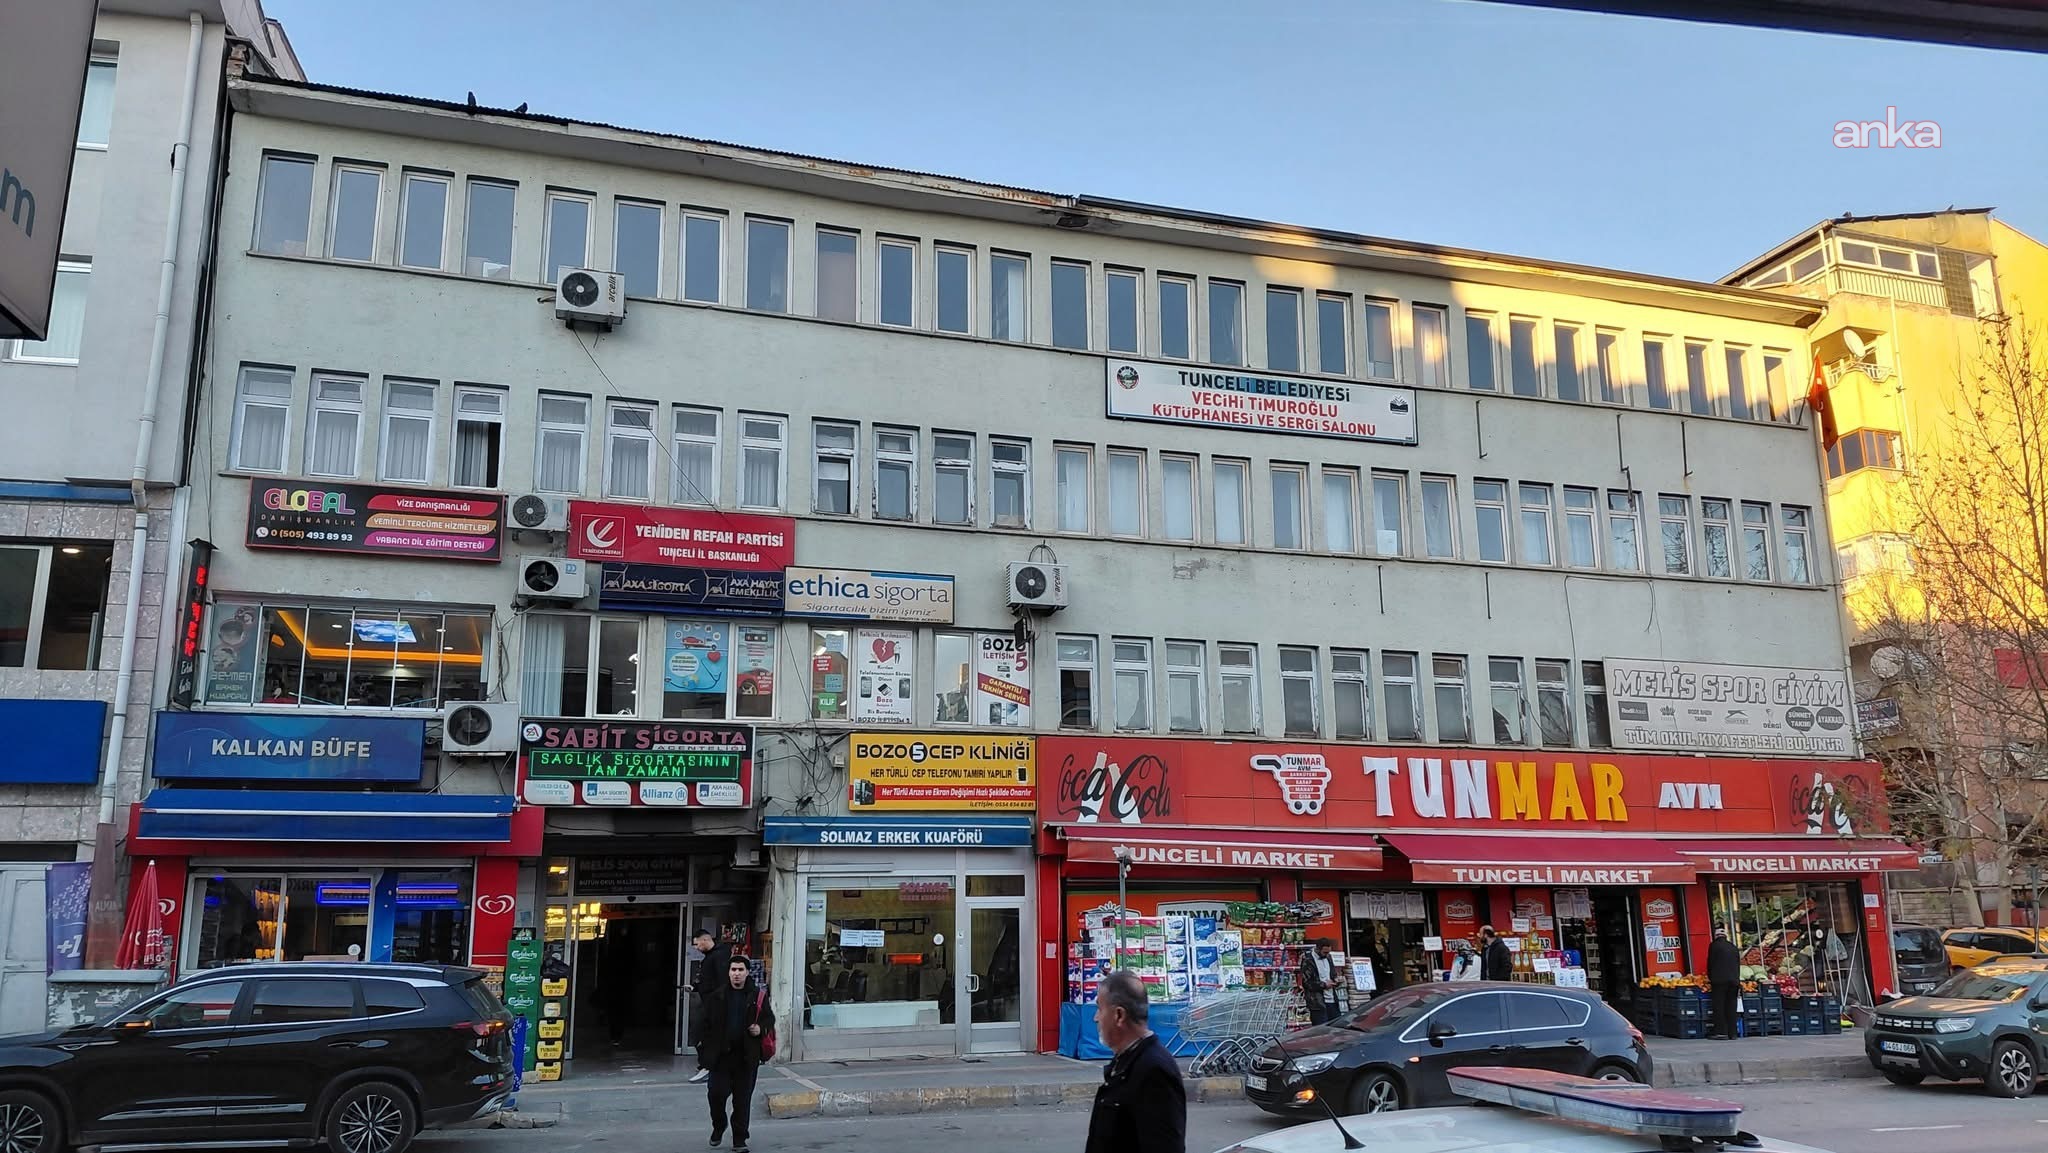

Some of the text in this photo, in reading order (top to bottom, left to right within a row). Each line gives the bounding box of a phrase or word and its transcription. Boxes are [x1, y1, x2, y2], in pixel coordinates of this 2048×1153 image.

[1178, 370, 1350, 402] TUNCELİ BELEDİYESİ
[1192, 391, 1338, 418] VECİHİ TİMUROĞLU
[1152, 403, 1376, 436] KÜTÜPHANESİ VE SERGİ SALONU
[263, 488, 356, 515] GLOBAL
[396, 498, 471, 512] VİZE DANIŞMANLIĞI
[261, 513, 356, 527] DANIŞMANLIK
[373, 516, 490, 532] YEMİNLİ TERCÜME HİZMETLERİ
[271, 529, 353, 542] 0 (505) 493 89 93
[635, 522, 784, 547] YENİDEN REFAH PARTİSİ
[375, 536, 485, 550] YABANCI DİL EĞİTİM DESTEĞİ
[697, 548, 706, 559] İL
[708, 550, 760, 563] BAŞKANLIĞI
[623, 579, 645, 590] AXA
[730, 578, 779, 590] AXA HAYAT
[788, 575, 949, 607] ethica sigorta
[870, 606, 899, 615] bizim
[984, 651, 1015, 660] İLETİŞİM
[1016, 652, 1027, 671] 5
[981, 683, 1026, 703] TEKNİK SERVİS
[989, 678, 1022, 694] GARANTİLİ
[1613, 666, 1844, 707] MELİS SPOR GİYİM
[544, 724, 747, 749] SABİT SİGORTA
[1625, 726, 1845, 751] TÜM OKUL KIYAFETLERİ BULUNUR
[211, 736, 371, 759] KALKAN BÜFE
[857, 744, 907, 759] BOZO
[929, 745, 965, 759] CEP
[970, 741, 1030, 761] KLİNİĞİ
[1286, 757, 1321, 765] TUNMAR
[586, 764, 687, 777] TAM ZAMANI
[870, 766, 1012, 778] HER TÜRLÜ CEP TELEFONU TAMİRİ YAPILIR
[881, 787, 892, 796] Her
[894, 787, 907, 796] Türlü
[909, 788, 924, 796] Arıza
[932, 787, 949, 796] Ekran
[950, 788, 975, 797] Değişimi
[976, 788, 988, 796] Hızlı
[988, 788, 1008, 798] Şekilde
[1009, 788, 1031, 797] Onarılır
[1057, 752, 1171, 818] Coca Cola
[1362, 756, 1628, 821] TUNMAR
[642, 789, 674, 799] Allianz
[1659, 782, 1723, 809] AVM
[821, 830, 983, 844] SOLMAZ ERKEK KUAFÖRÜ
[1113, 845, 1334, 867] UNCELİ MARKET
[1710, 856, 1882, 871] TUNCELİ MARKET
[1452, 867, 1652, 884] TUNCELİ MARKET
[1448, 907, 1472, 915] Banvit
[1649, 906, 1671, 914] Banvit
[57, 934, 84, 958] +1
[1219, 941, 1239, 954] Solo
[512, 950, 538, 960] Carlsberg
[1658, 952, 1675, 961] AVM
[509, 974, 536, 983] Carlsberg
[508, 996, 534, 1006] Carlsberg
